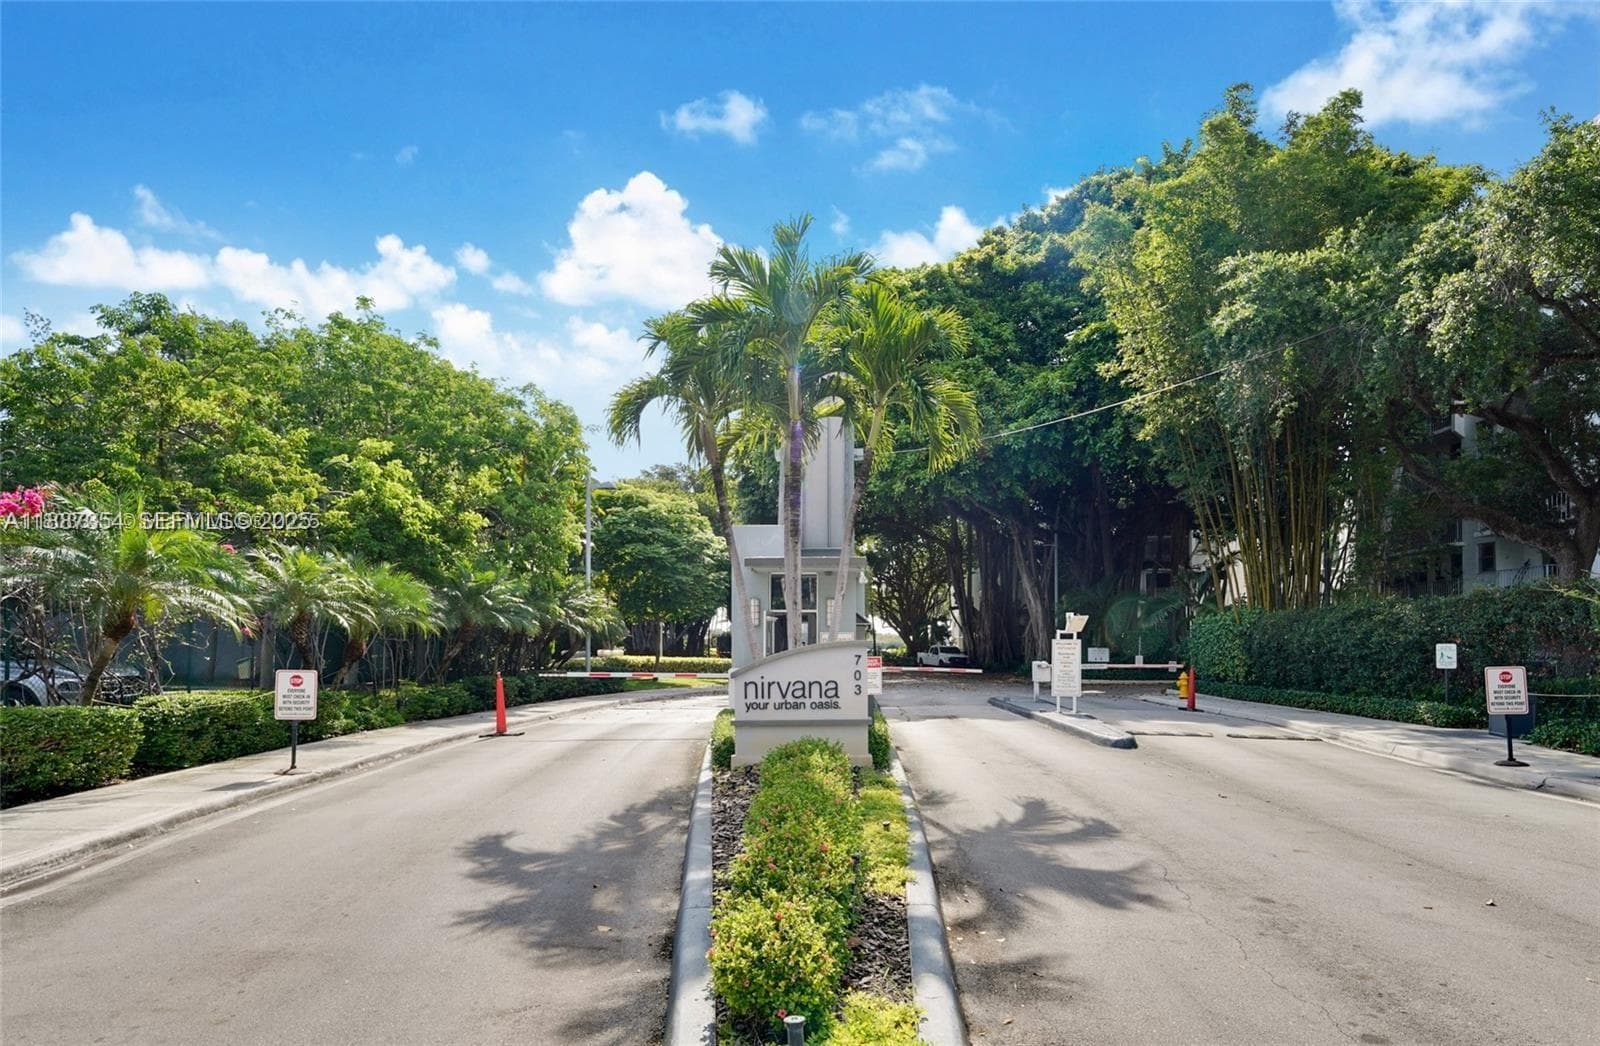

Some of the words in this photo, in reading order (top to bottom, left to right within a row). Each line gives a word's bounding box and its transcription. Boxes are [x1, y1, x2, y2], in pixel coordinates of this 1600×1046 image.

[744, 676, 840, 699] nirvana
[745, 701, 769, 712] your
[773, 700, 806, 710] urban
[810, 700, 841, 710] oasis.
